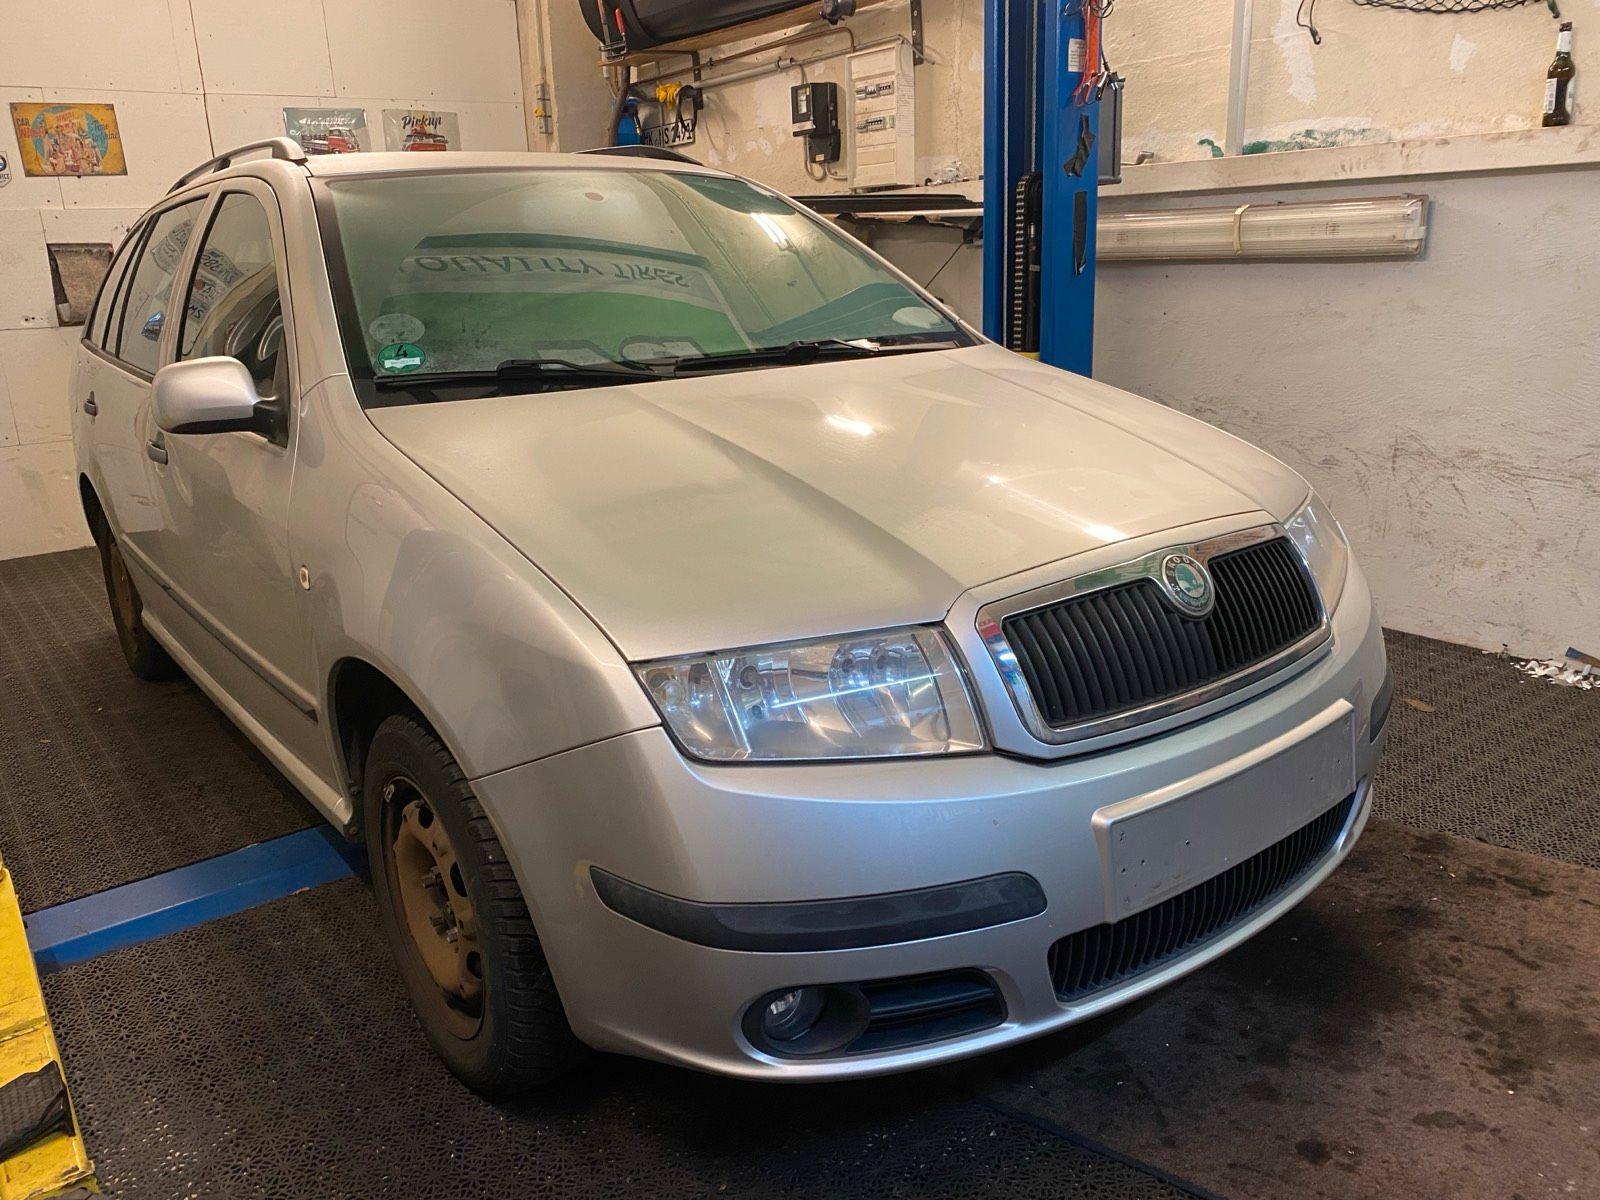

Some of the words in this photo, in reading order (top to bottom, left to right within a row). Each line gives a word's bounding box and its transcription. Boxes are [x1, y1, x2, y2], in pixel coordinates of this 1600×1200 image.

[16, 117, 31, 127] CAR
[401, 115, 441, 130] Pickup
[395, 344, 408, 358] 4
